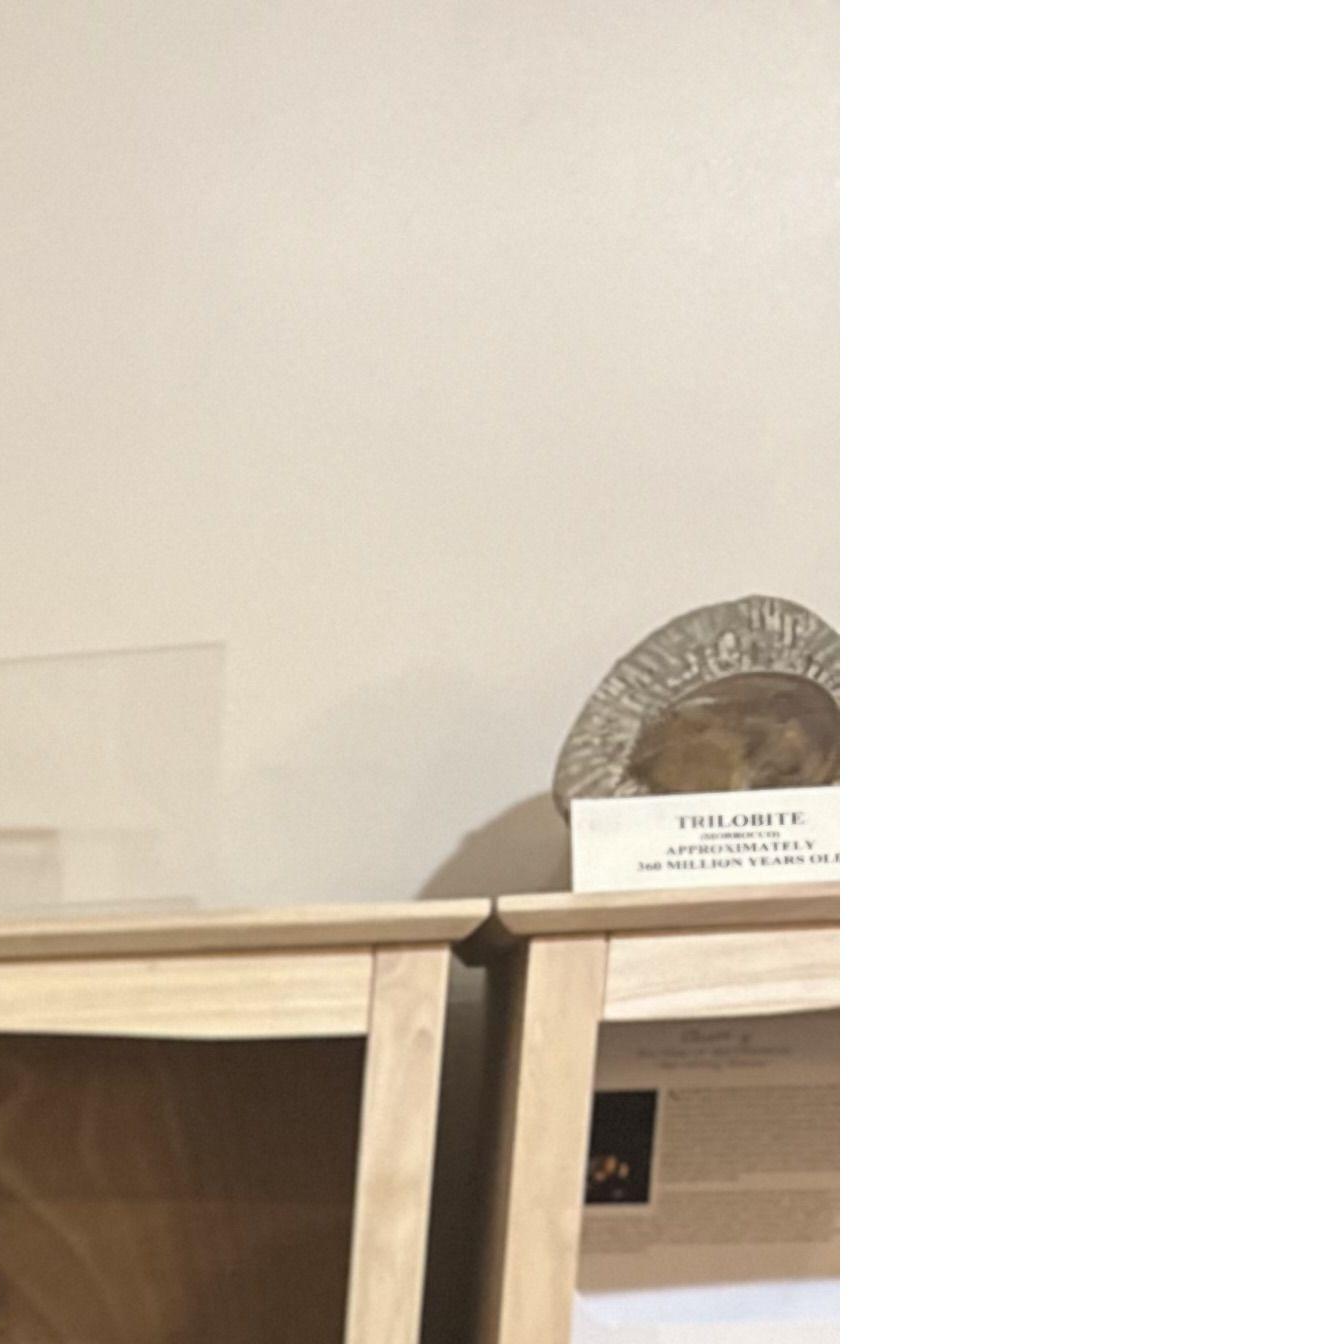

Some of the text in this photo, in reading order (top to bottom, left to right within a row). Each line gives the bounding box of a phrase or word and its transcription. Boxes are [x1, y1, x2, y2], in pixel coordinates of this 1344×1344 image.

[675, 812, 807, 829] TRILOBITE
[666, 840, 815, 855] APPROXIMATELY
[667, 857, 743, 871] MILLION
[748, 854, 805, 867] YEARS
